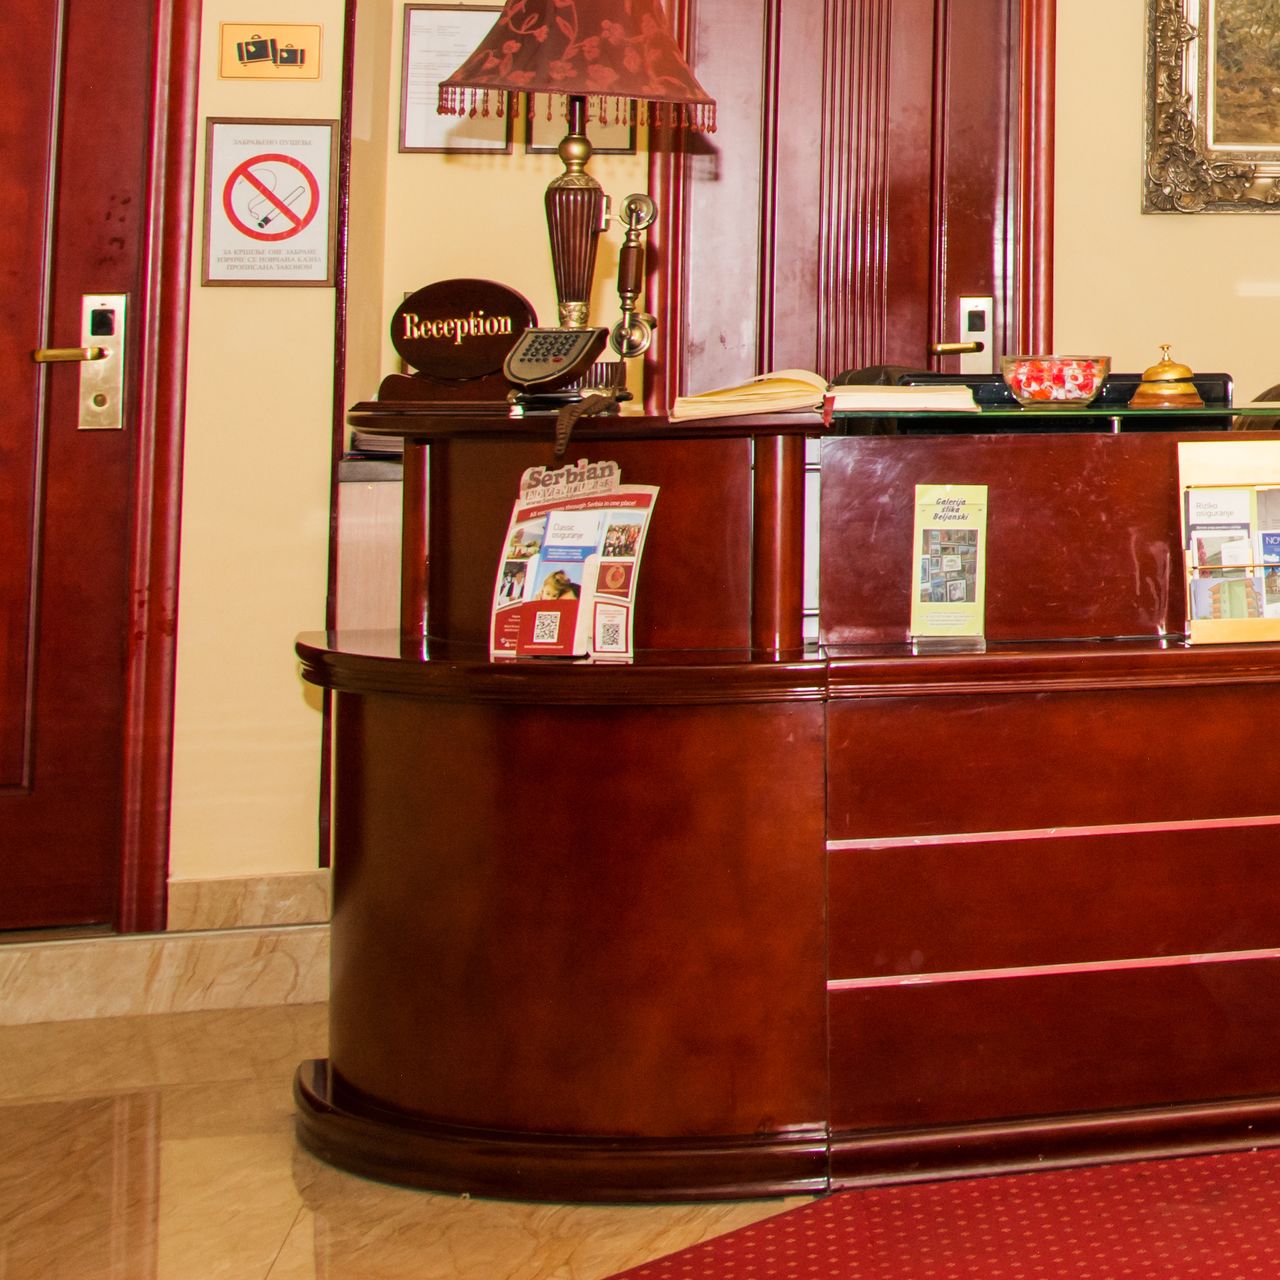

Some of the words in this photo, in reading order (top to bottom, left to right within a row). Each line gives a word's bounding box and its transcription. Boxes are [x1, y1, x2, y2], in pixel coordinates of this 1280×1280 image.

[402, 310, 513, 345] Reception
[527, 464, 615, 490] Serbian
[935, 498, 967, 507] Galerija
